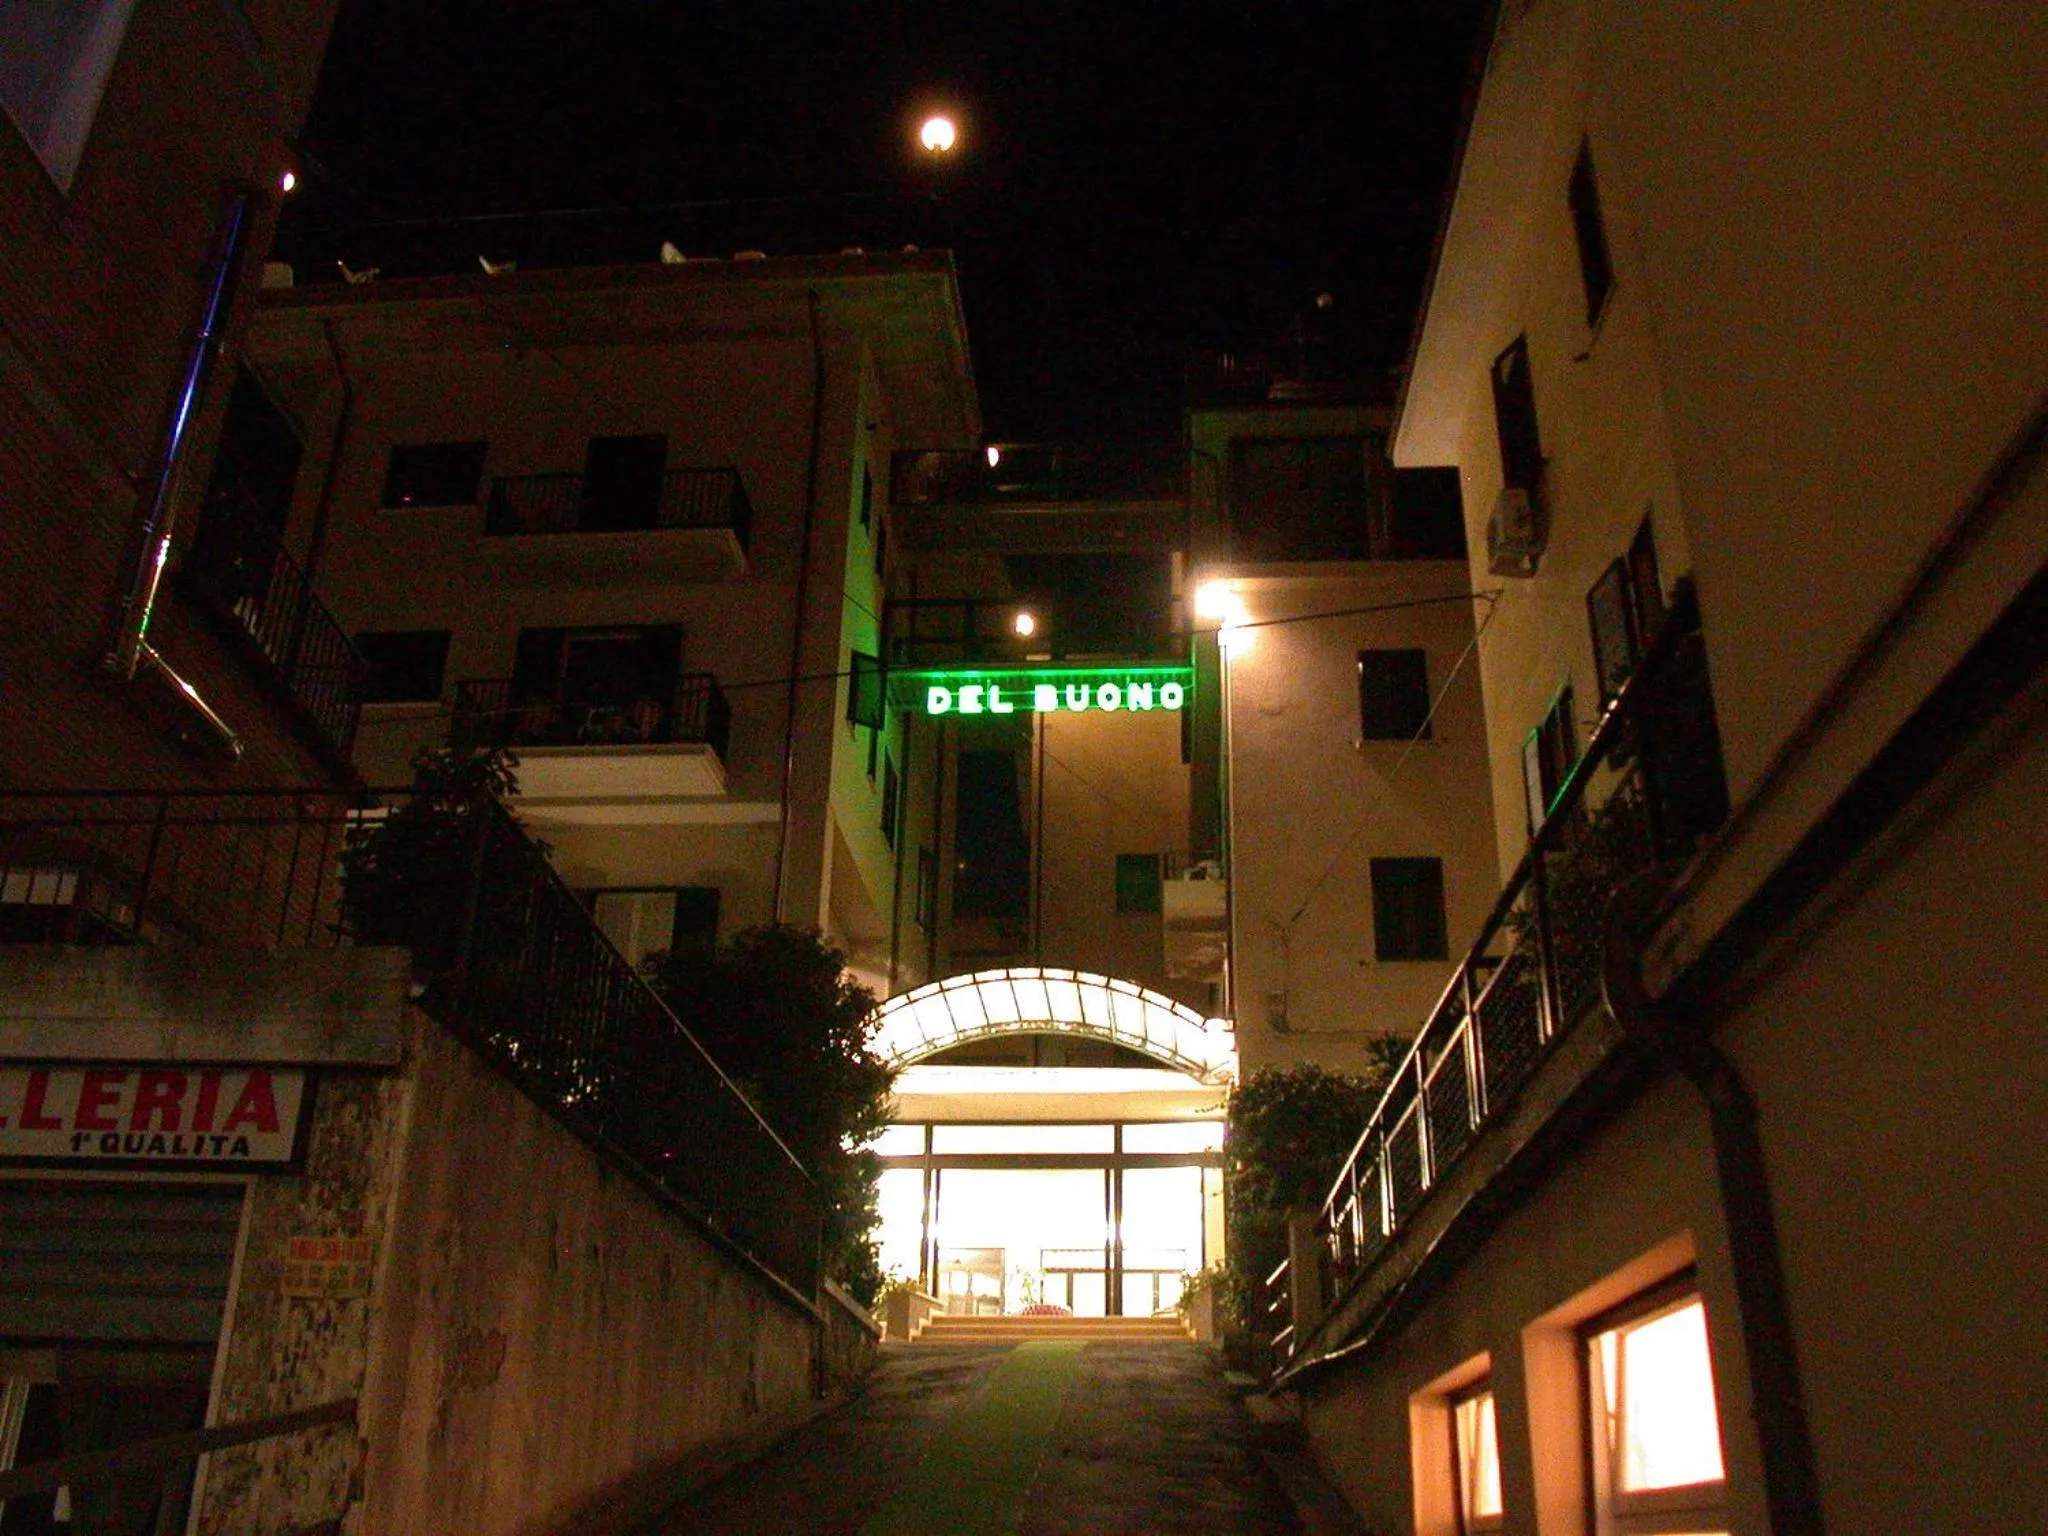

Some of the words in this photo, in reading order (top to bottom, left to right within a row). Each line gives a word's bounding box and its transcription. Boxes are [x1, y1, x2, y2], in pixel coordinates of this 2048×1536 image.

[927, 685, 1014, 714] DEL
[1034, 682, 1184, 713] BUONO
[0, 1068, 280, 1133] LERIA
[100, 1133, 250, 1156] QUALITA
